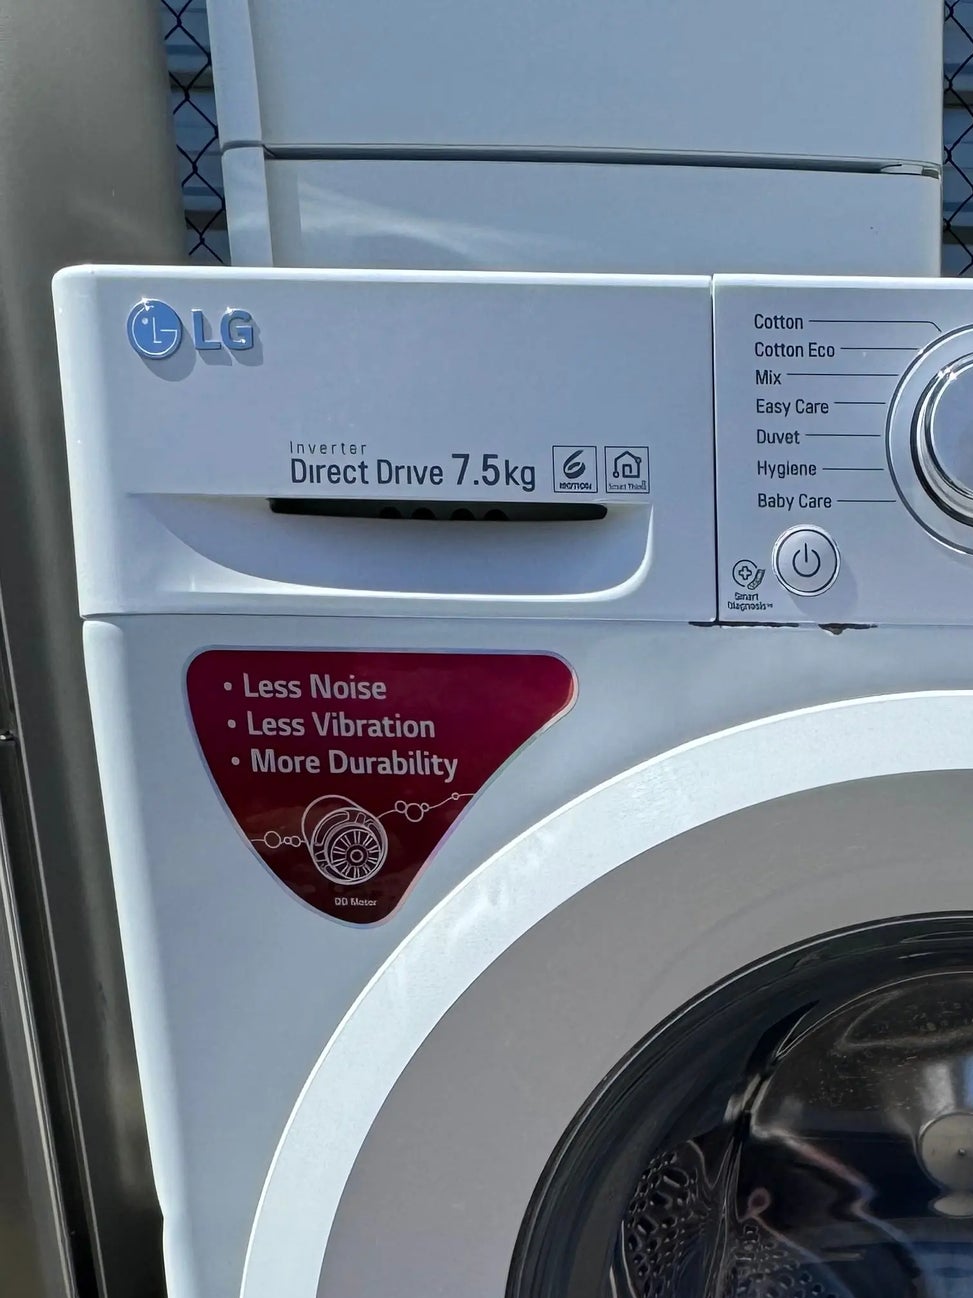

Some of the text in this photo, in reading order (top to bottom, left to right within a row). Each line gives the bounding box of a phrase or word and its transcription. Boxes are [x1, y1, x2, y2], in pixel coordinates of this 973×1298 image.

[191, 307, 254, 350] LG
[754, 313, 804, 330] Cotton
[754, 341, 835, 357] Cotton Eco
[755, 369, 782, 385] Mix
[756, 398, 829, 417] Easy Care
[756, 429, 800, 444] Duvet
[290, 441, 367, 455] Inverter
[291, 458, 369, 484] Direct
[377, 459, 443, 485] Drive
[757, 460, 817, 479] Hygiene
[758, 493, 832, 512] Baby Care
[243, 673, 387, 700] Less Noise
[247, 711, 436, 738] Less Vibration
[251, 749, 458, 783] More Durability
